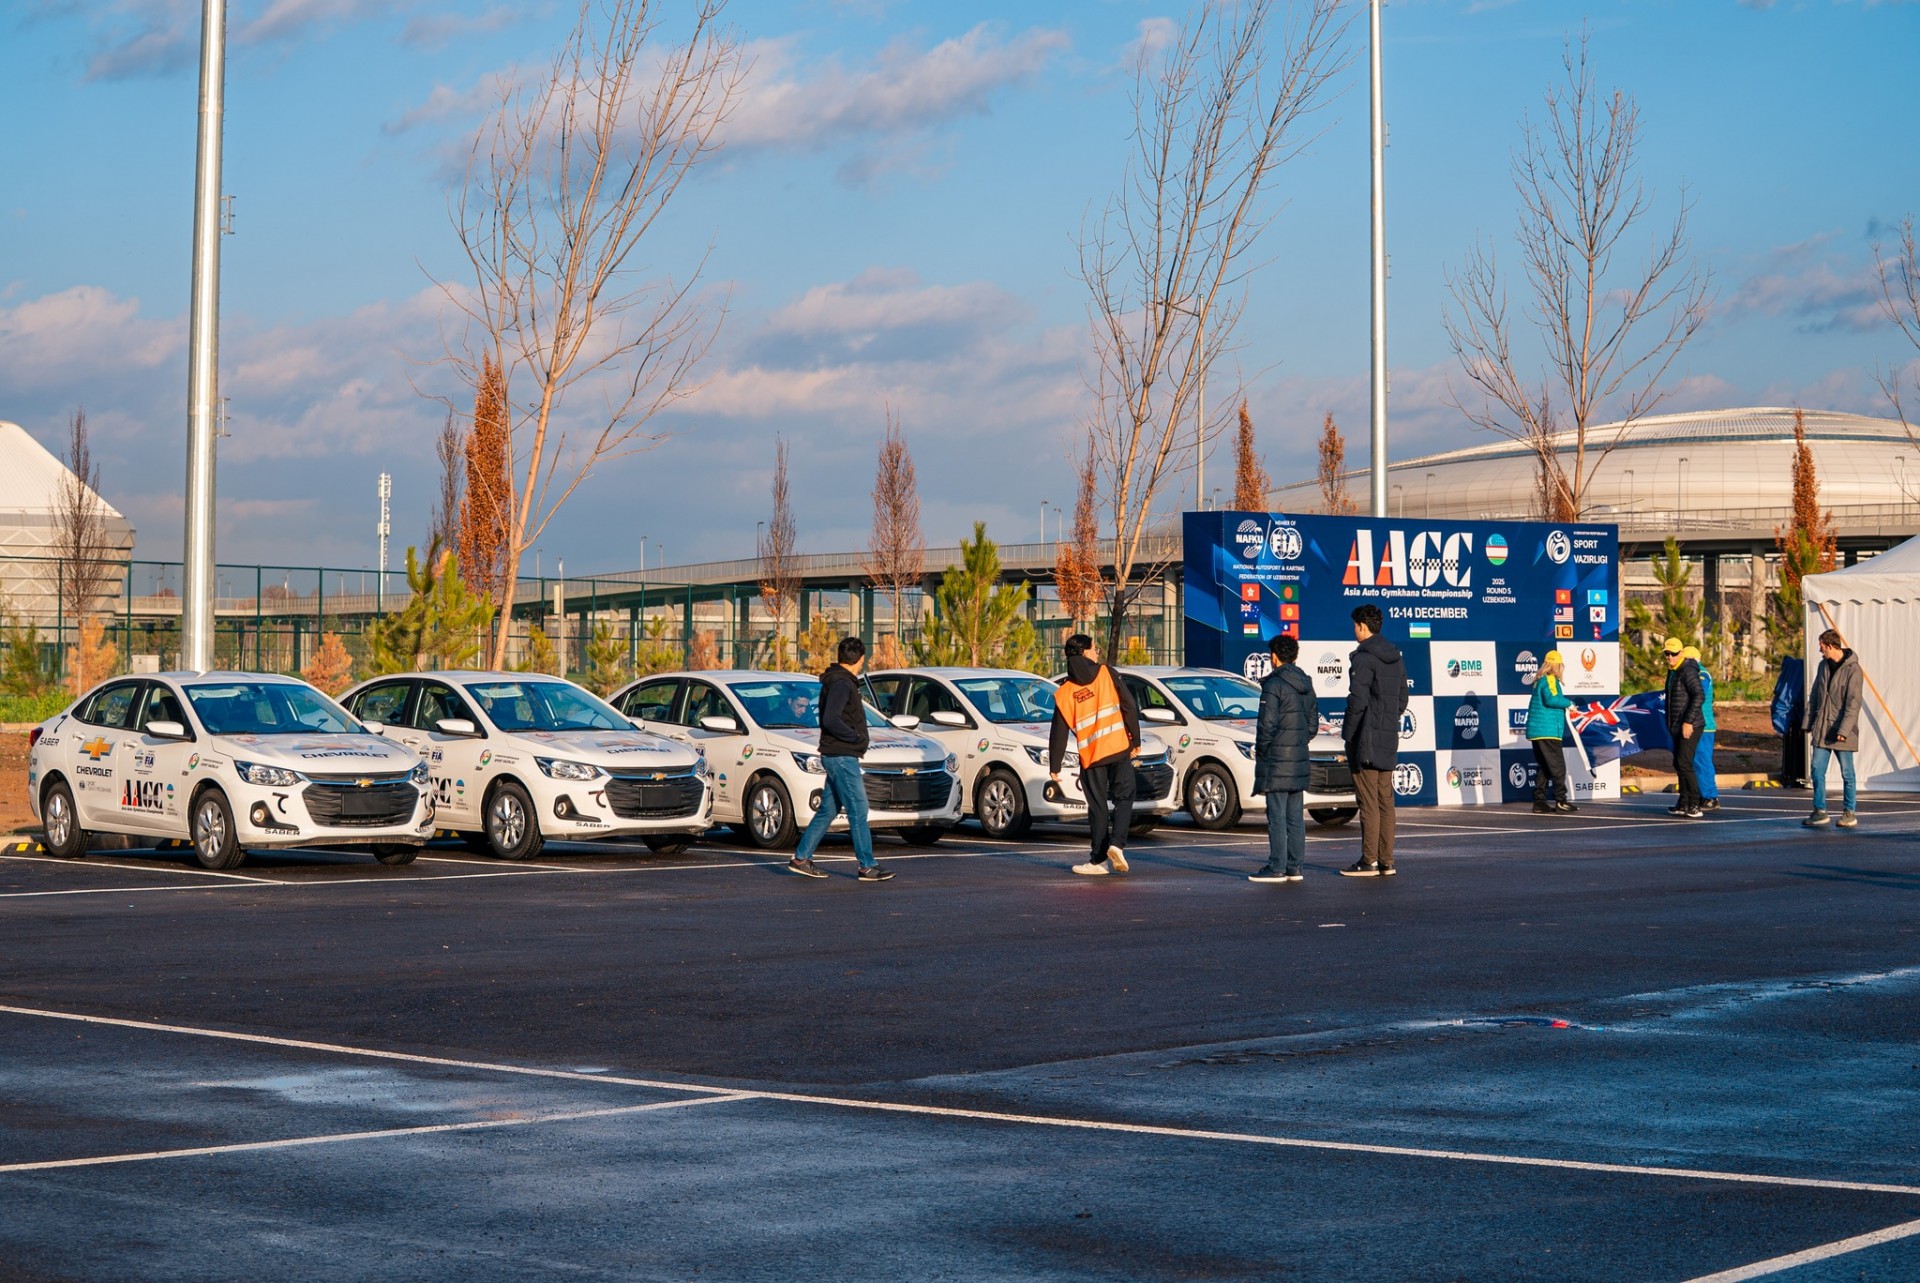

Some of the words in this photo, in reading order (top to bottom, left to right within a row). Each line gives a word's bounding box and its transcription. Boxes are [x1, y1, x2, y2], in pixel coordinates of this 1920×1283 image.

[1236, 534, 1264, 544] NAFKU
[1574, 540, 1598, 548] SPORT
[1574, 554, 1608, 564] VAZIRLIGI
[1344, 588, 1360, 596] Asia
[1362, 588, 1379, 596] Auto
[1381, 588, 1420, 598] Gymkhana
[1422, 589, 1472, 599] Championship
[1388, 607, 1413, 618] 12-14
[1414, 608, 1468, 618] DECEMBER
[1461, 660, 1482, 670] BMB
[1515, 664, 1538, 672] NAFKU
[1455, 718, 1479, 726] NAFKU
[40, 738, 59, 746] SABER
[302, 751, 389, 759] CHEVROLET
[76, 766, 113, 777] CHEVROLET
[1576, 783, 1606, 791] SABER
